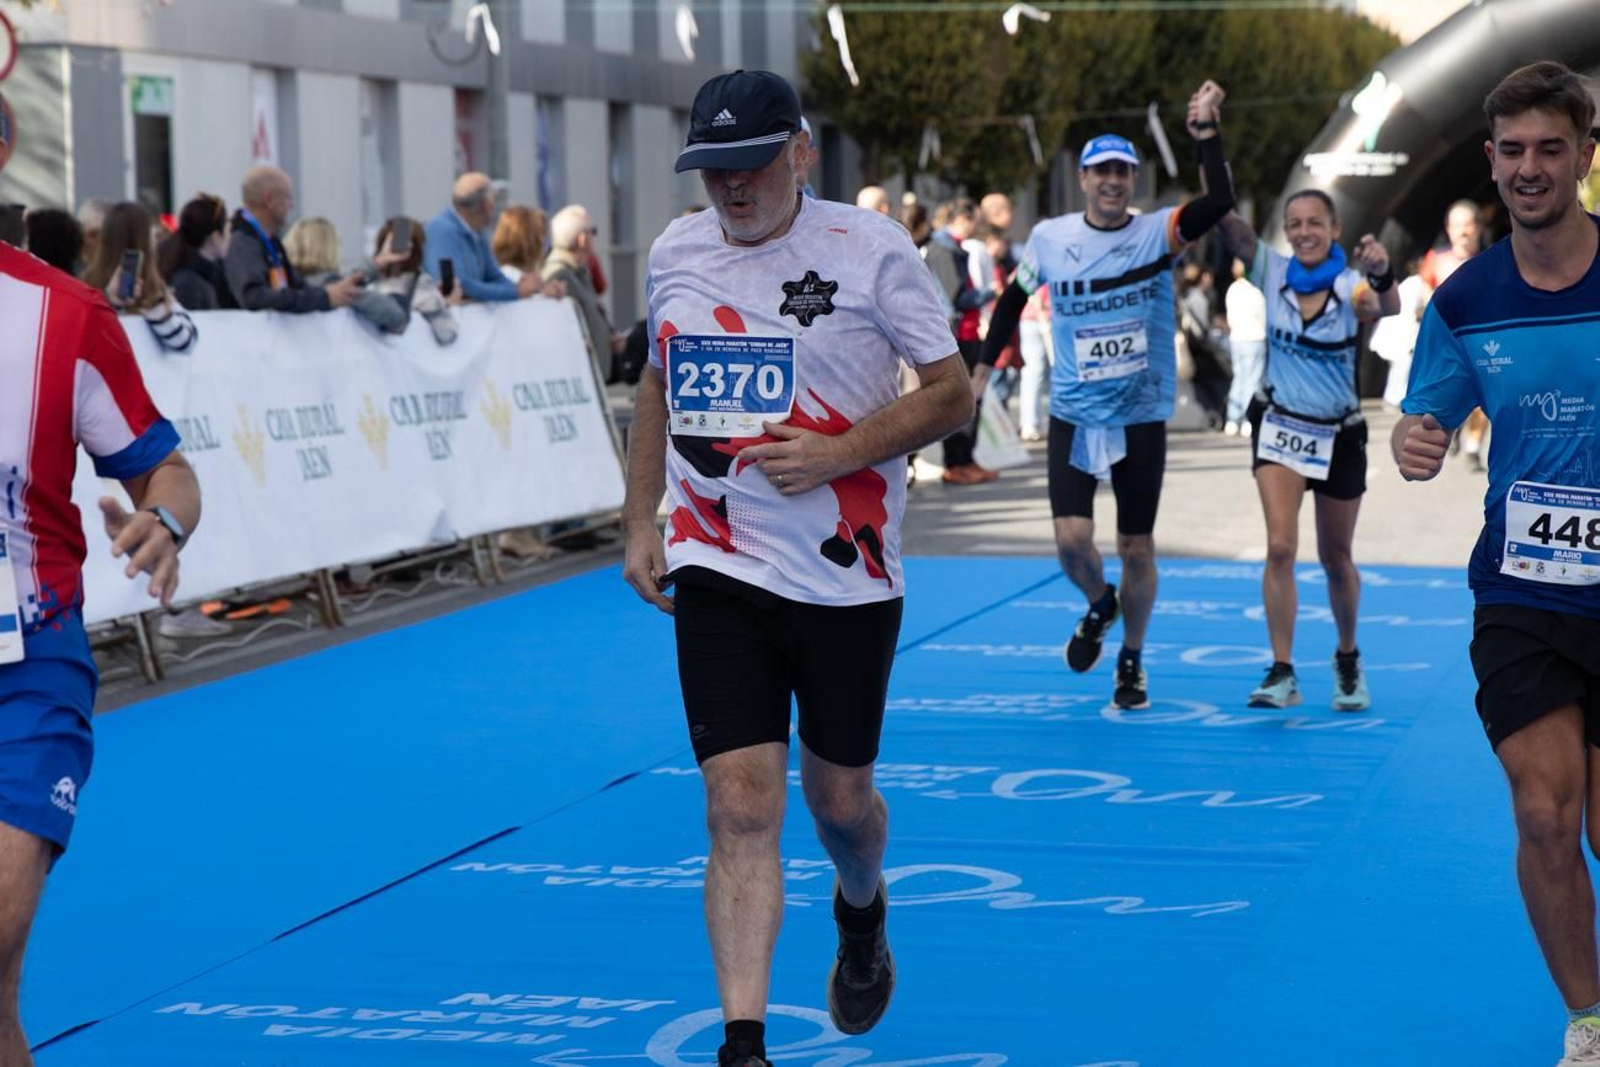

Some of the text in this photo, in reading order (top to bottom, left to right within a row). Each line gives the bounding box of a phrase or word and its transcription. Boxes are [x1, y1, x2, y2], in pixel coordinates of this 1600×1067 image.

[711, 117, 737, 127] adidas
[1090, 337, 1135, 358] 402
[677, 362, 784, 400] 2370
[710, 399, 744, 408] MANUEL
[1560, 404, 1595, 413] MARATÓN
[1275, 432, 1317, 456] 504
[1528, 513, 1600, 551] 448
[1553, 551, 1582, 560] MARIO
[543, 876, 706, 888] EDIA
[440, 992, 678, 1012] JAÉN
[154, 1002, 618, 1029] MARATÓN
[263, 1024, 567, 1045] MEDIA
